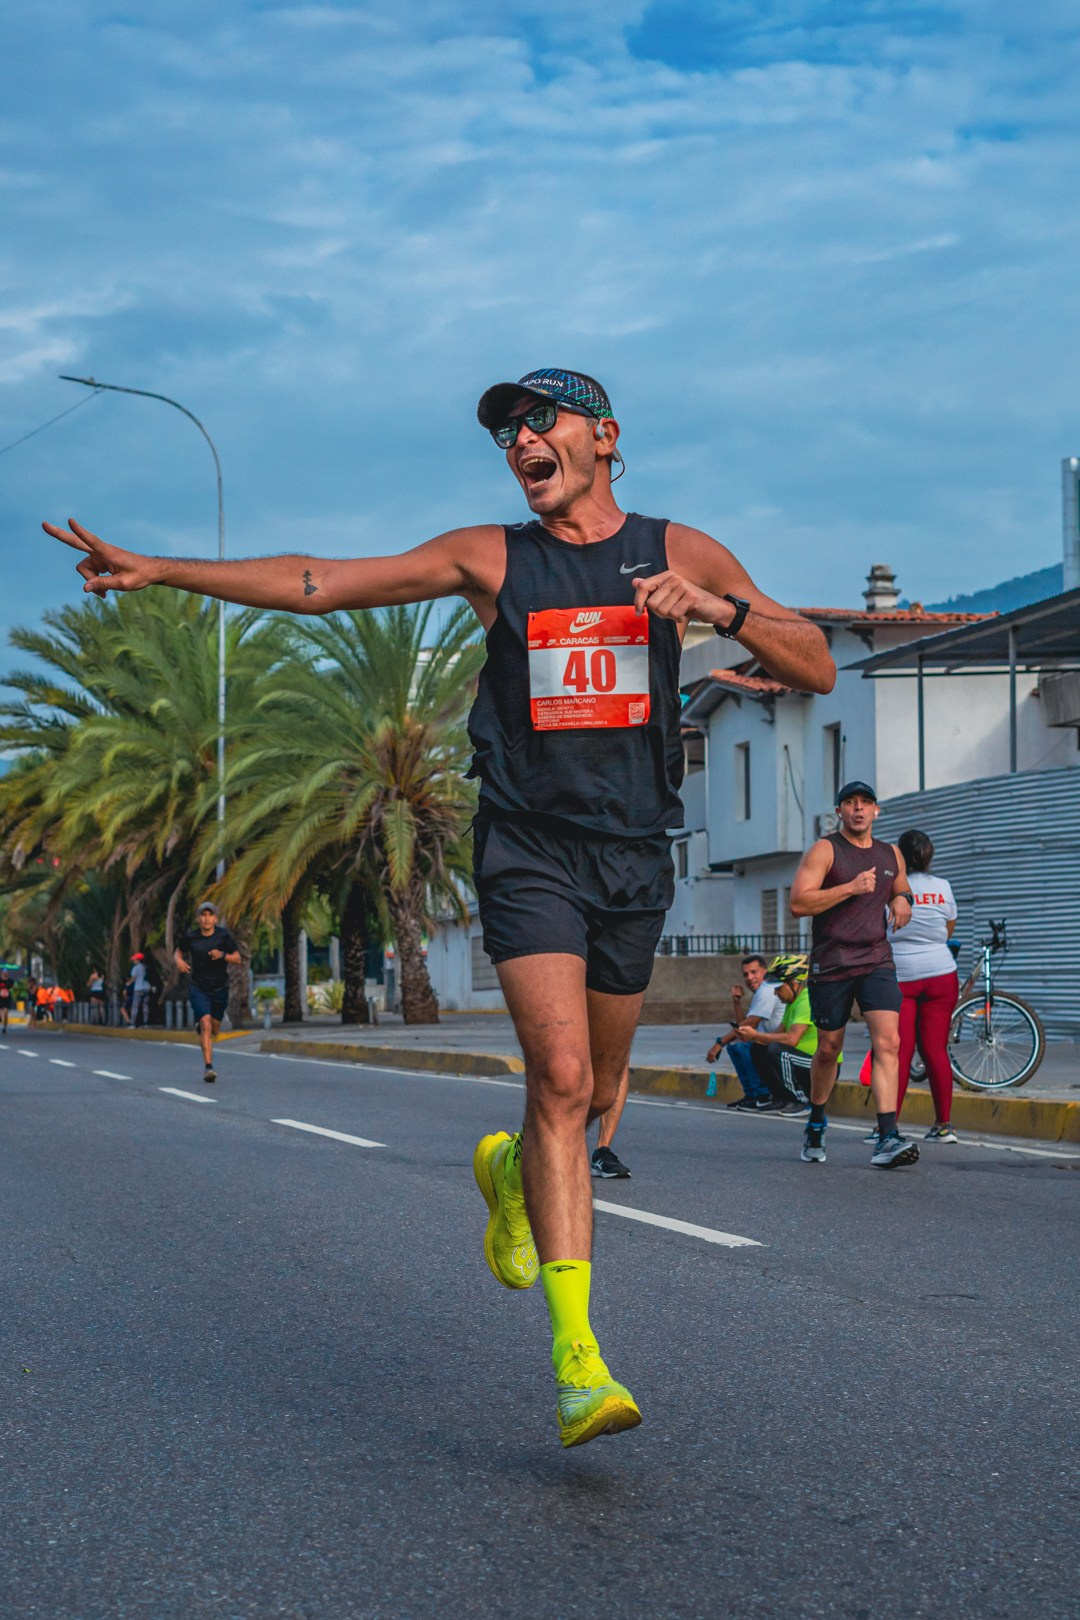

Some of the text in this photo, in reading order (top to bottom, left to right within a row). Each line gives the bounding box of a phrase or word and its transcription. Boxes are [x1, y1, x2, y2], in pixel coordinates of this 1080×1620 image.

[542, 378, 563, 387] RUN
[576, 611, 602, 624] RUN
[560, 636, 599, 645] CARACAS
[562, 649, 617, 693] 40
[914, 894, 945, 905] LETA
